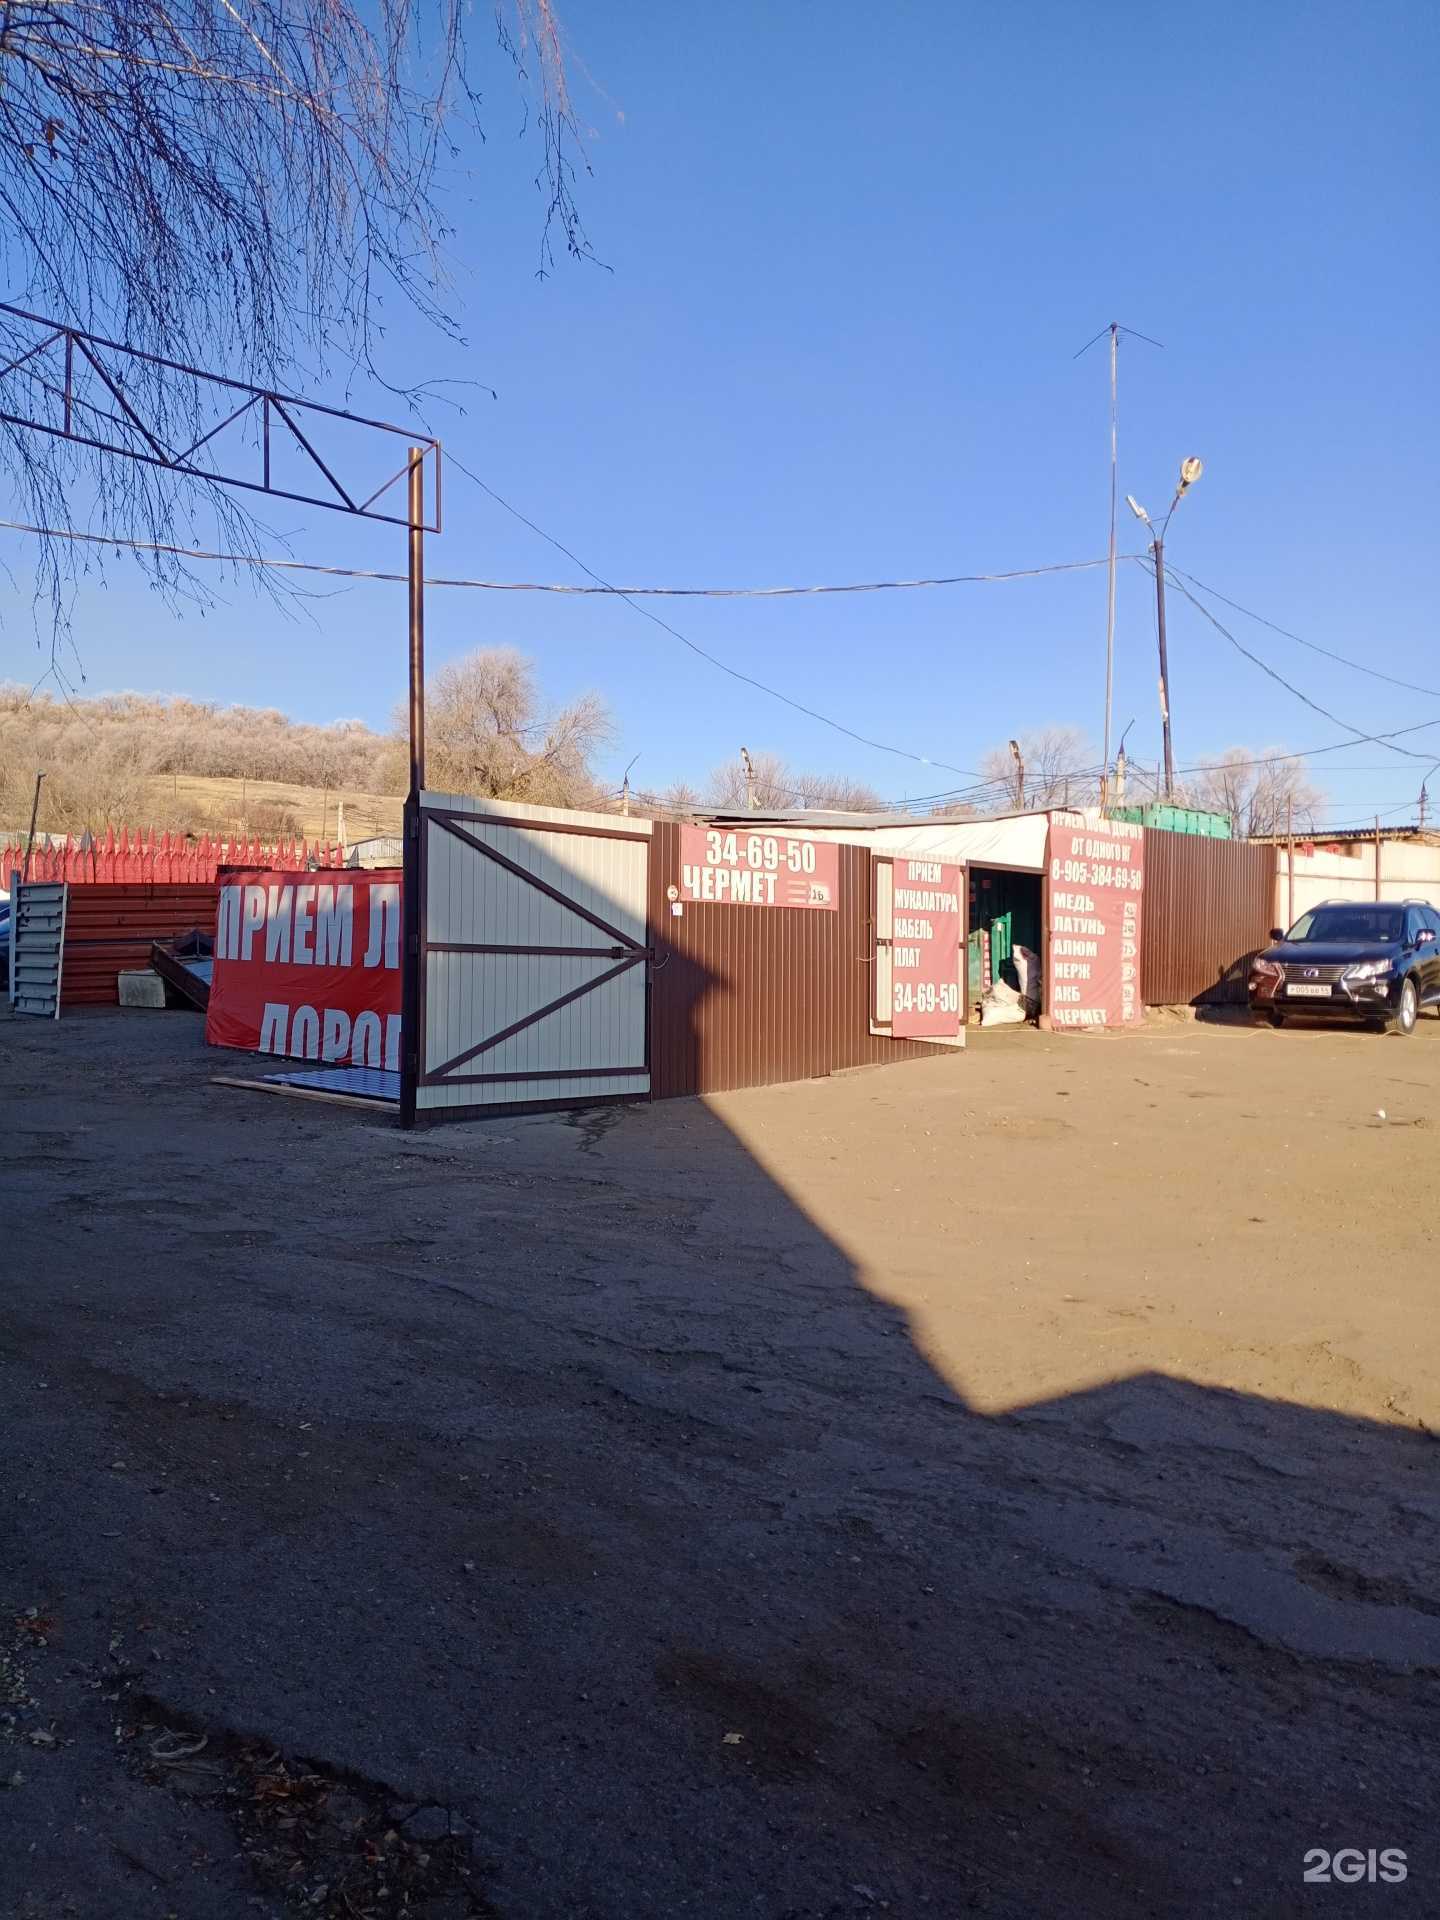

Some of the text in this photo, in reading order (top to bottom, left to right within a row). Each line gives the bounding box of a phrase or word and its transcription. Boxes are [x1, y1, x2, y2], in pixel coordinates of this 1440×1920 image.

[706, 831, 816, 873] 34-69-50
[1071, 837, 1084, 856] ОТ
[908, 861, 942, 883] ПРИЕМ
[1052, 858, 1142, 890] 8-905-384-69-50
[683, 864, 778, 904] ЧЕРМЕТ
[1054, 892, 1094, 912] МЕДЬ
[217, 884, 353, 967] ПРИЕМ
[895, 917, 933, 939] КАБЕЛЬ
[1055, 916, 1105, 935] ЛАТУНЬ
[895, 947, 920, 967] ПЛАТ
[1054, 939, 1097, 957] АЛЮМ
[1055, 962, 1090, 979] НЕРЖ
[895, 982, 958, 1012] 34-69-50
[1055, 986, 1080, 1001] АКБ
[1055, 1008, 1106, 1025] ЧЕРМЕТ
